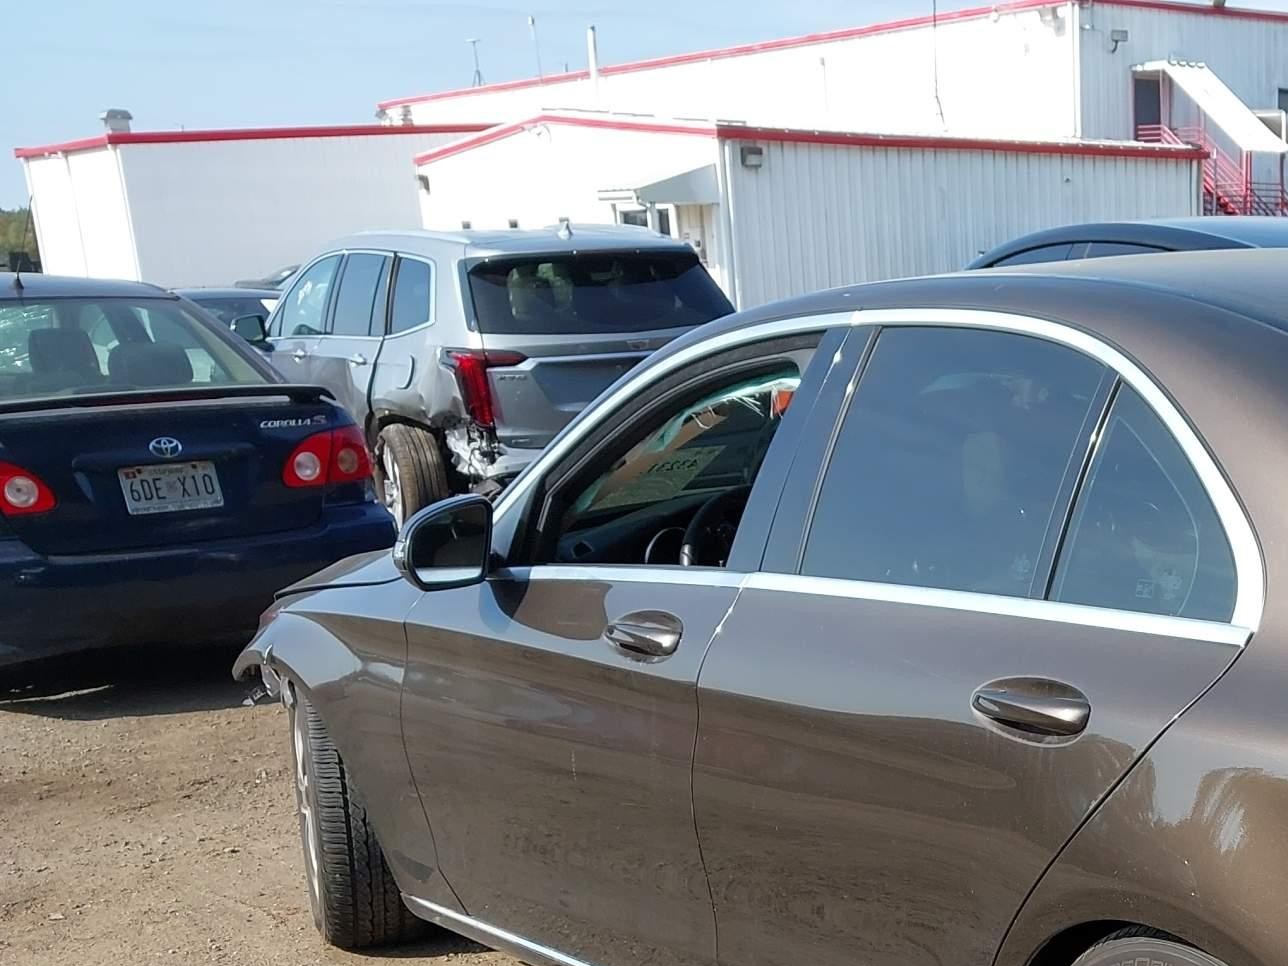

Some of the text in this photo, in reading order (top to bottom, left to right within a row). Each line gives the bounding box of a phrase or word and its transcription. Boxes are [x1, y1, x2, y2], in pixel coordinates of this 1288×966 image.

[260, 415, 327, 428] COROLLA S
[130, 478, 167, 502] 6DE
